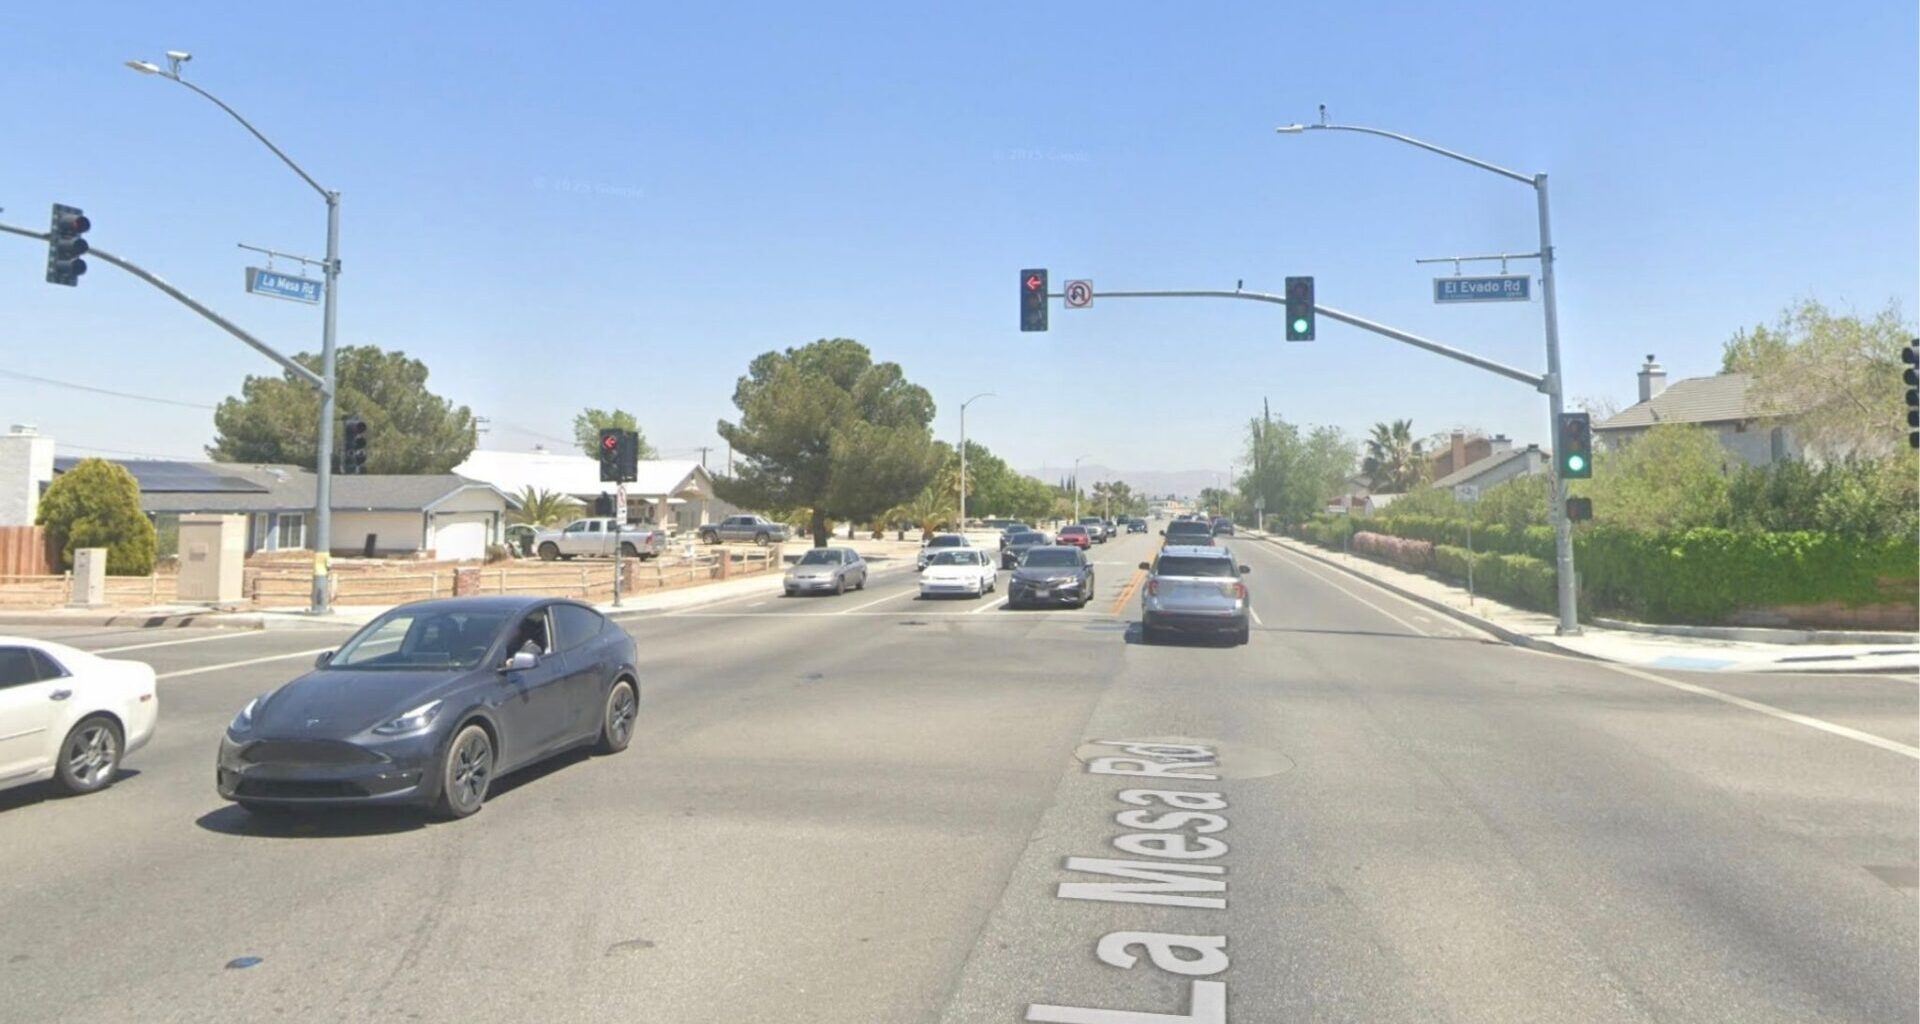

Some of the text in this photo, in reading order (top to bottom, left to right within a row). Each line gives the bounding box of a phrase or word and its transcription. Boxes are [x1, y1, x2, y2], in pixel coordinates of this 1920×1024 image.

[262, 273, 315, 295] La Mesa Rd
[1444, 280, 1521, 294] El Evado Rd
